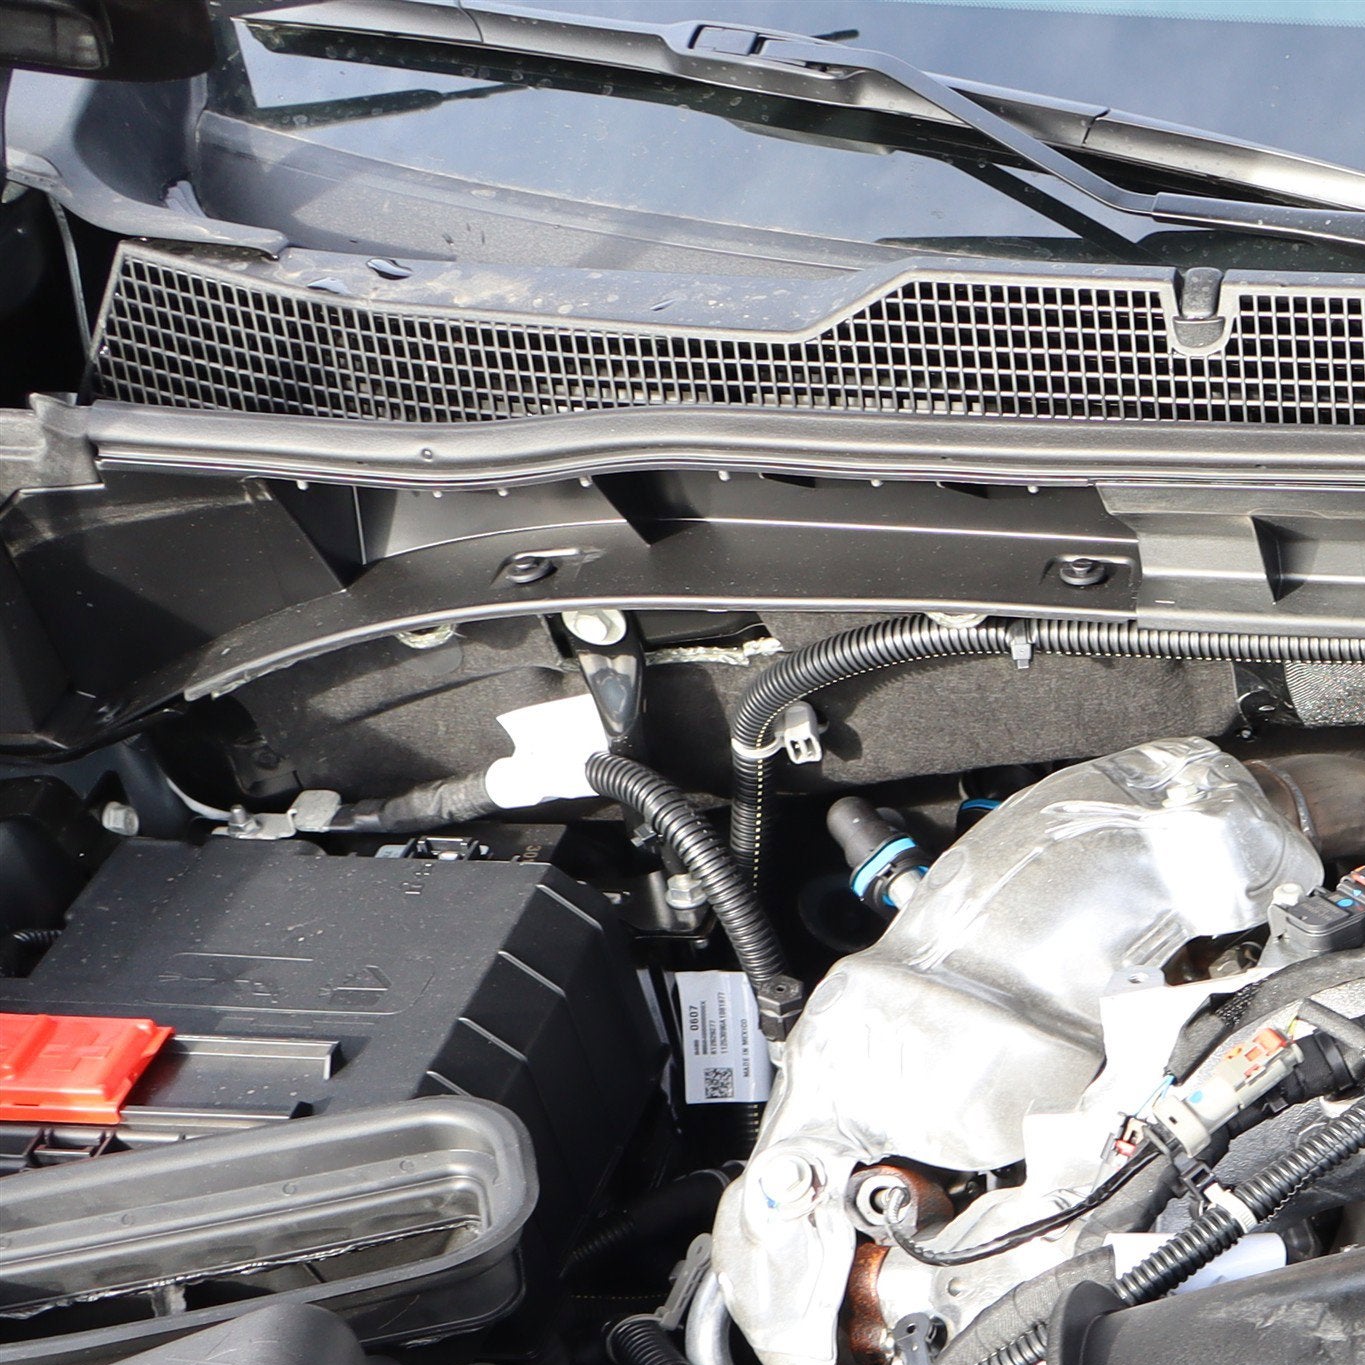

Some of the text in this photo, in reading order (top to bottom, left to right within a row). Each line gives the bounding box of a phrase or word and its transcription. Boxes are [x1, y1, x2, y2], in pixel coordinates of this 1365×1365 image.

[689, 1005, 699, 1031] 0607
[740, 1018, 750, 1078] MADE IN MEXICO
